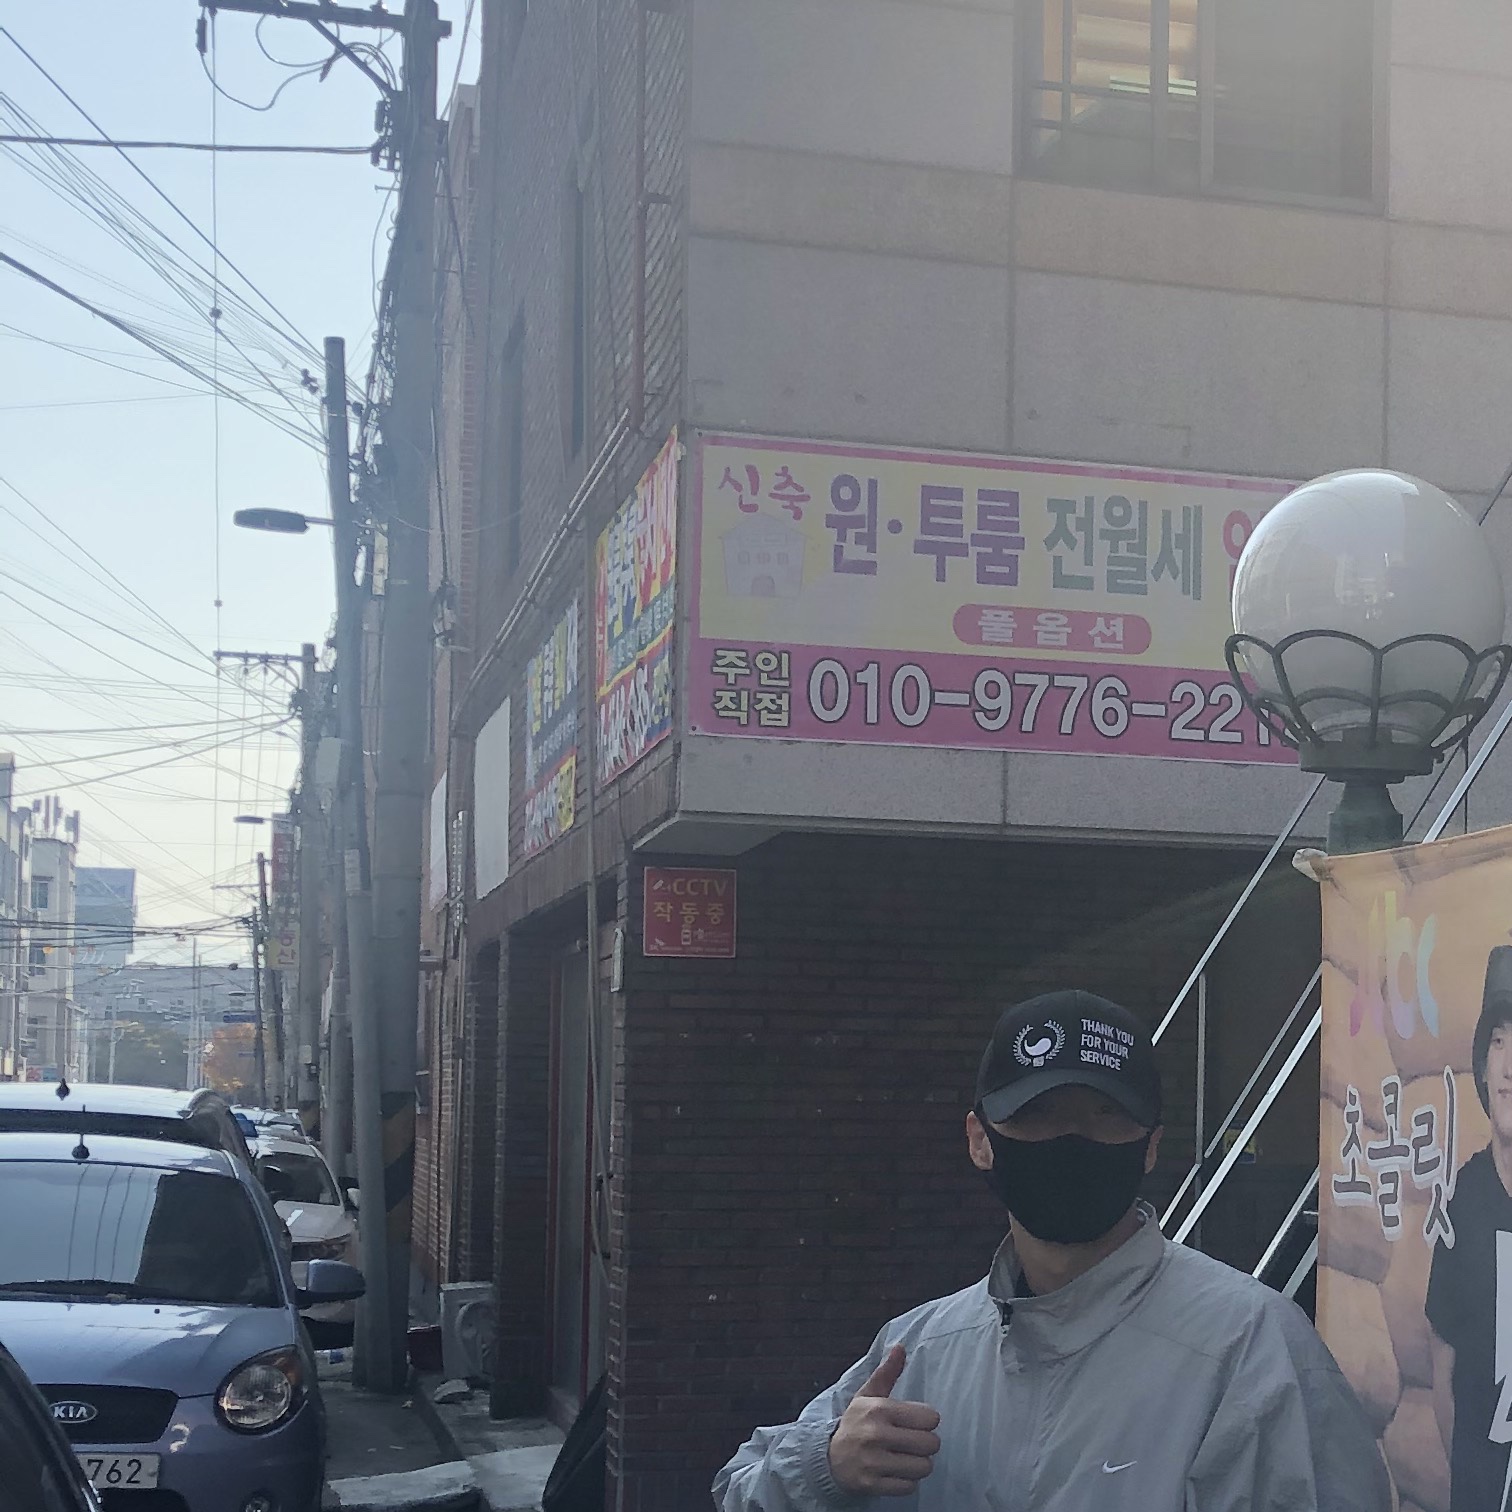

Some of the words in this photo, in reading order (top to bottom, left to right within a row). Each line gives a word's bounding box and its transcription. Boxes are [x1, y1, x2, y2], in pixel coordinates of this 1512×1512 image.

[718, 464, 812, 521] 신축
[1043, 494, 1203, 601] 전월세
[712, 649, 790, 687] 주인
[713, 690, 790, 728] 직접
[809, 657, 1299, 746] 010-9776-221
[672, 878, 728, 896] CCTV
[653, 901, 725, 925] 작동중
[1080, 1034, 1102, 1050] FOR
[1103, 1039, 1130, 1059] YOUR
[1081, 1018, 1115, 1038] THANK
[1115, 1028, 1135, 1047] YOU
[1080, 1050, 1122, 1071] SERVICE
[1332, 1065, 1458, 1249] 초콜릿
[53, 1405, 88, 1419] KIA
